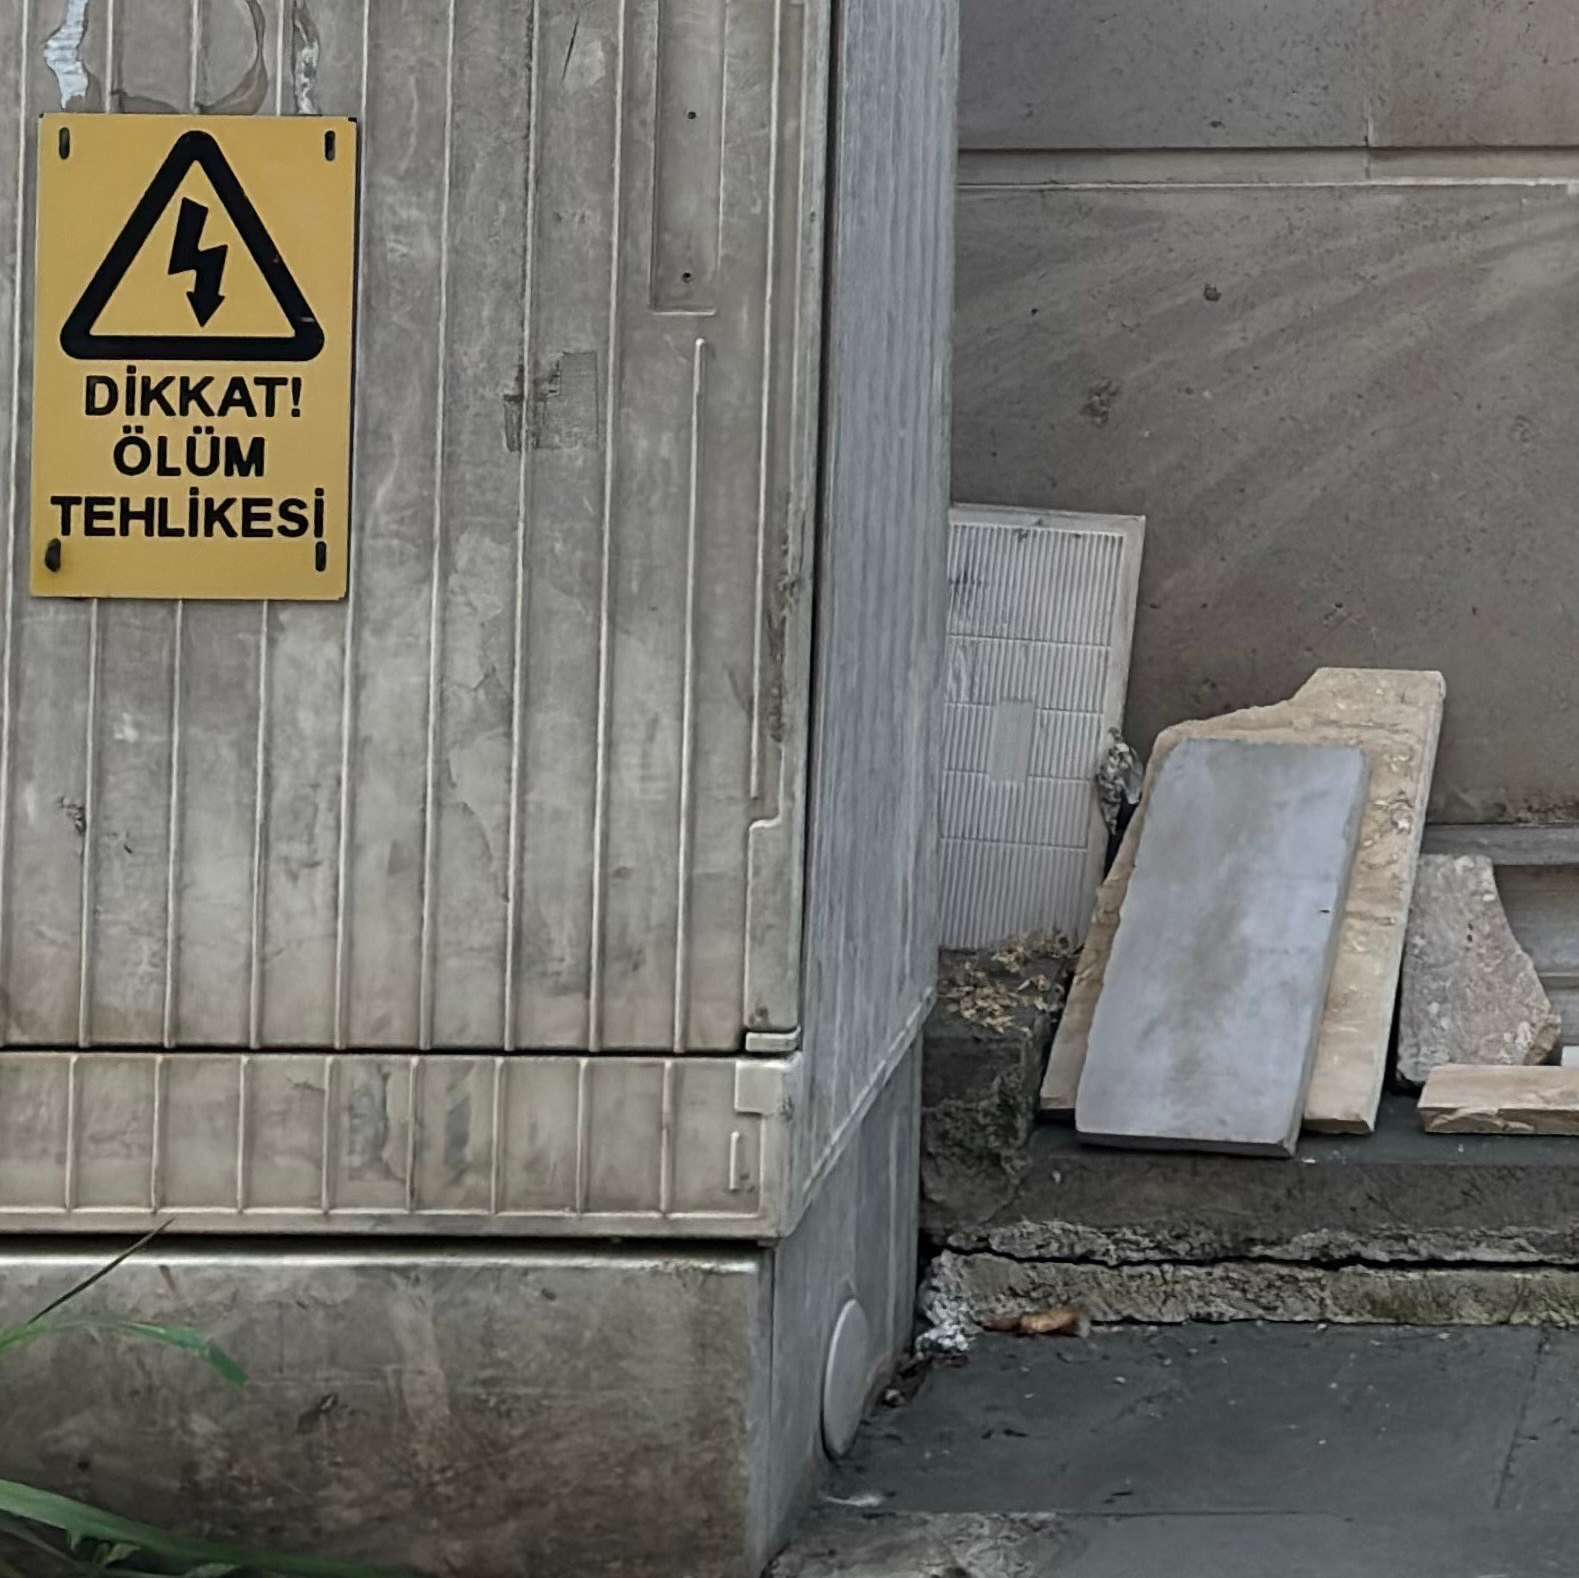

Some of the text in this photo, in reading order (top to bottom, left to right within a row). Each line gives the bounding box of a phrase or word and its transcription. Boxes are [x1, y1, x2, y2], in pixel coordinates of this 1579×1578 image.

[84, 365, 302, 418] DİKKAT!
[113, 425, 266, 477] ÖLÜM
[50, 487, 325, 538] TEHLİKESİ
